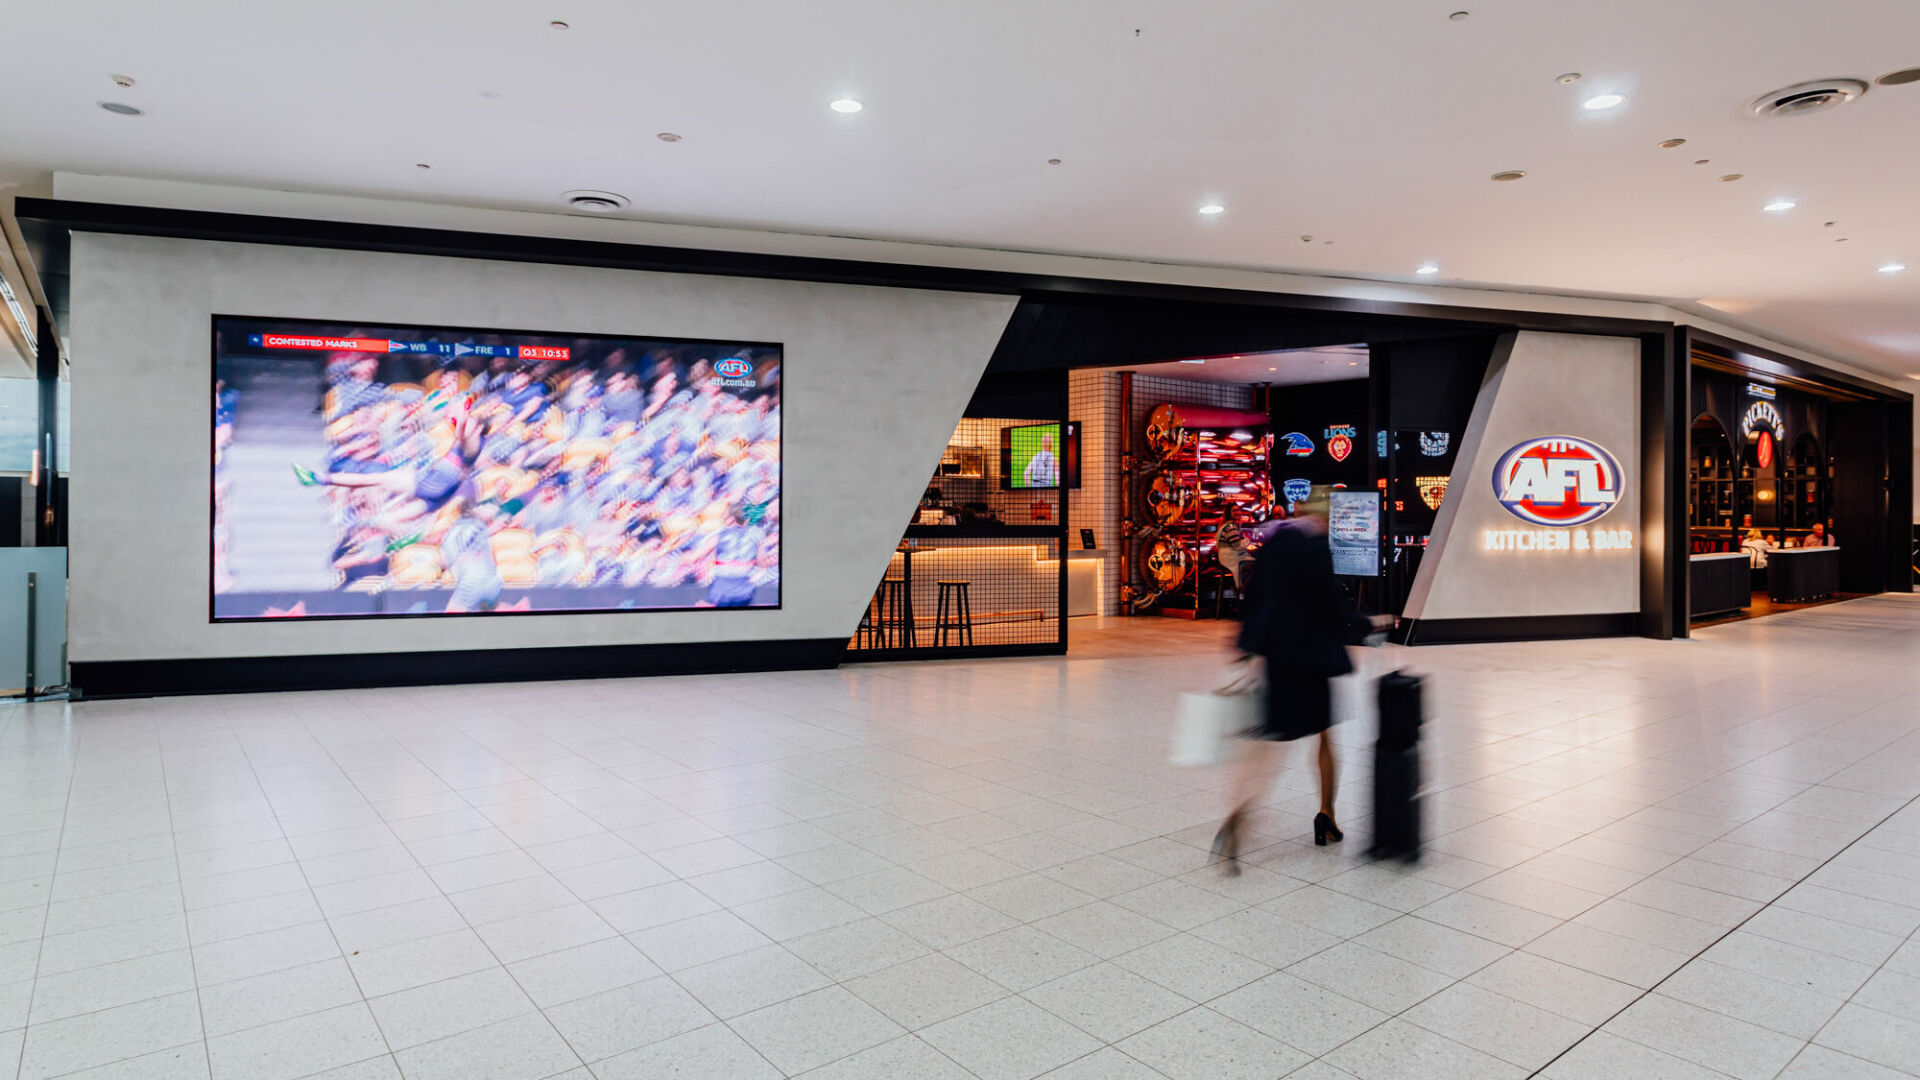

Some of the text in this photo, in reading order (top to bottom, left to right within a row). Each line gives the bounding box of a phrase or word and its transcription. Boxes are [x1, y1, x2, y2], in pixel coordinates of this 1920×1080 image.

[269, 337, 358, 348] CONTESTED MARKS
[410, 343, 450, 352] WB 11
[475, 346, 494, 355] FRE
[720, 362, 749, 373] AFL
[1742, 401, 1784, 441] PICKETT'S
[1324, 427, 1356, 439] LIONS
[1500, 458, 1617, 503] AFL
[1486, 530, 1632, 550] KITCHEN & BAR
